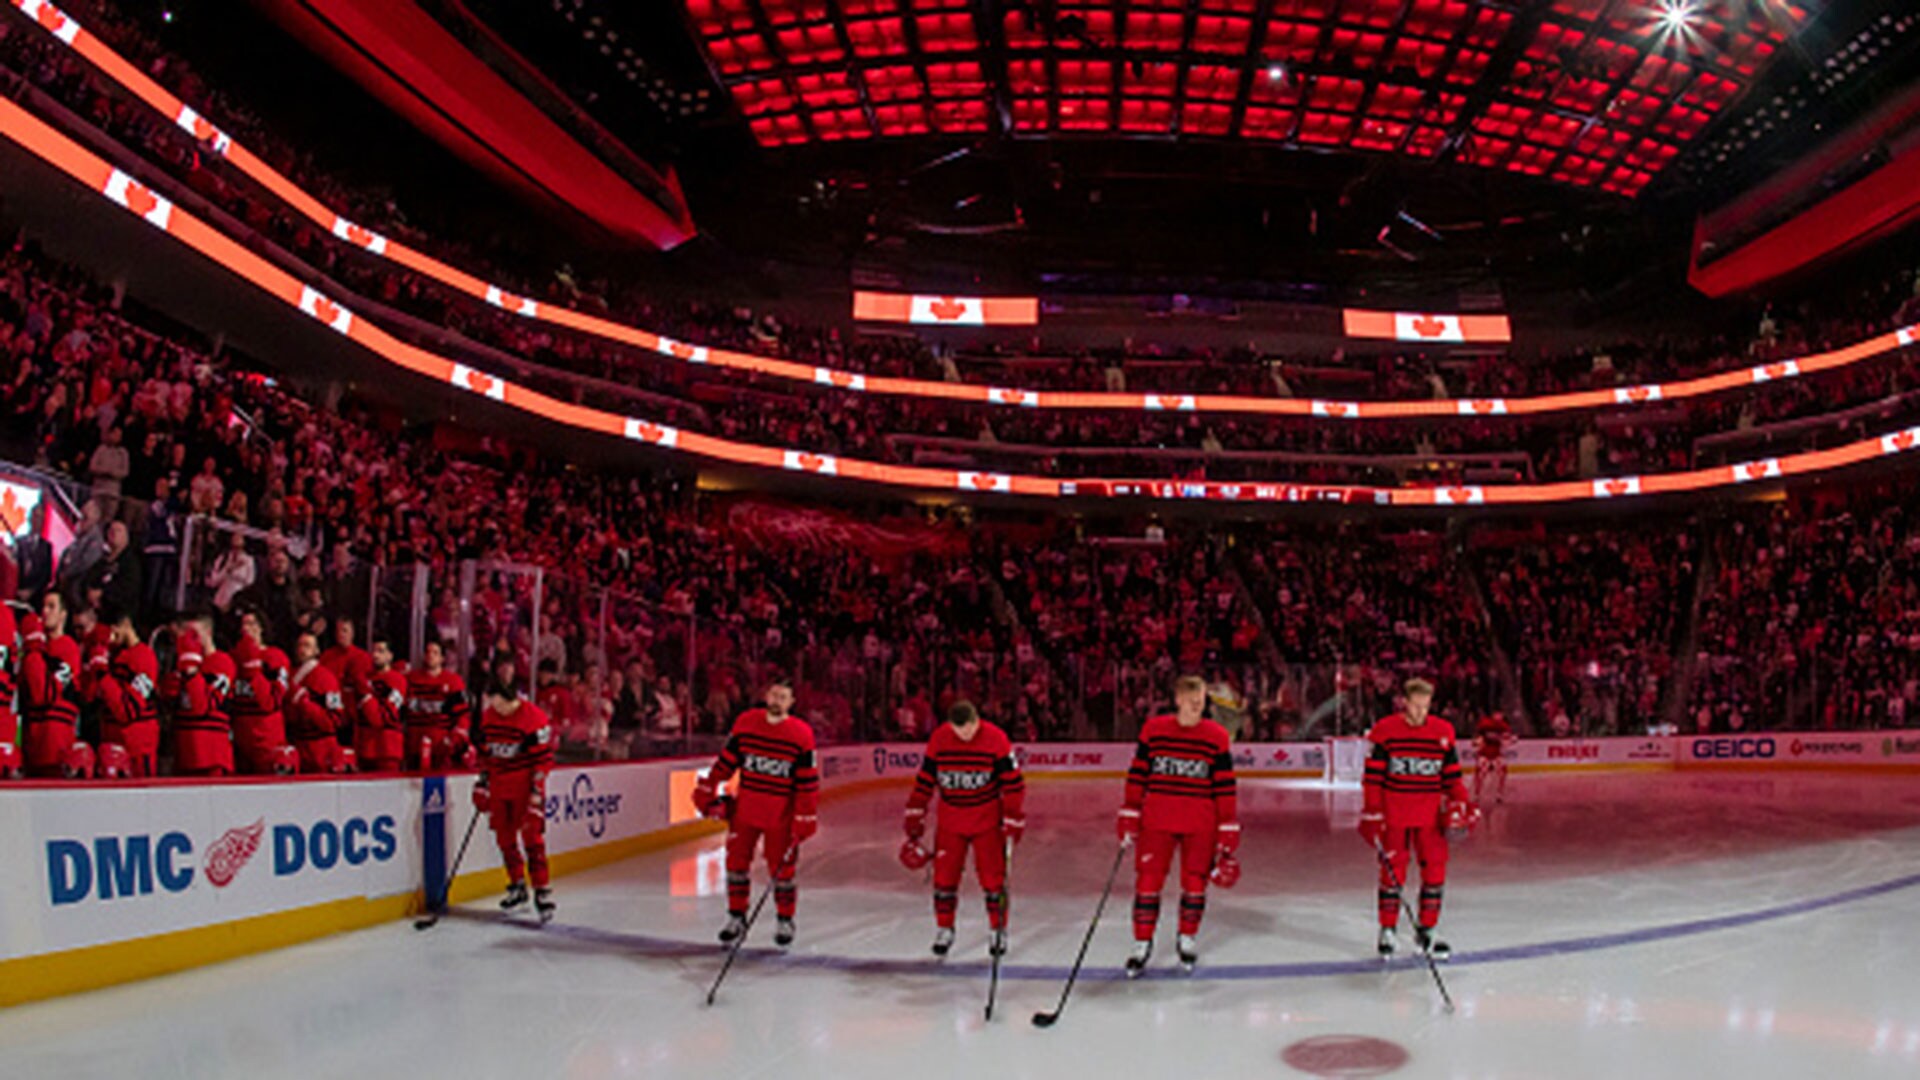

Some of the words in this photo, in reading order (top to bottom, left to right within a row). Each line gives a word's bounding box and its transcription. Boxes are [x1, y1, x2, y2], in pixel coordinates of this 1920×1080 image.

[1692, 738, 1776, 758] GEICO
[564, 773, 622, 839] Kroger
[46, 831, 195, 906] DMC
[272, 814, 396, 876] DOCS
